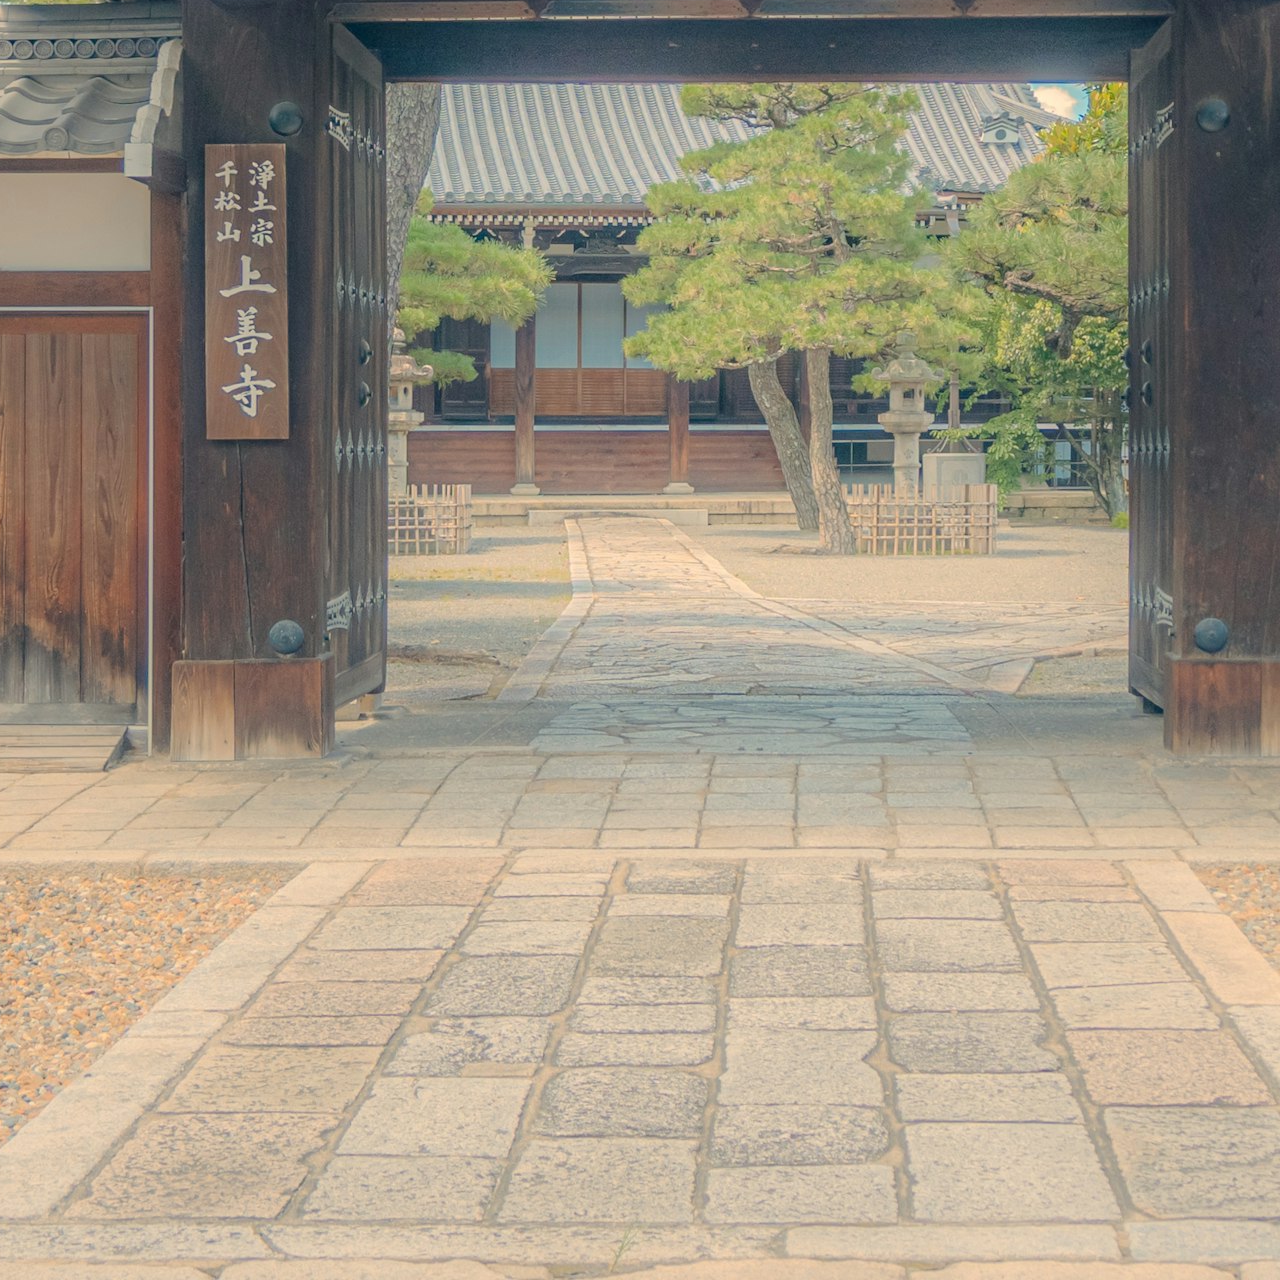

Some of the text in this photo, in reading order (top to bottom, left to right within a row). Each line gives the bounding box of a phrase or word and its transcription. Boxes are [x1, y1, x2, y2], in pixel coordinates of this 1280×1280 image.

[214, 160, 242, 243] 千松山
[218, 254, 278, 418] 上善寺
